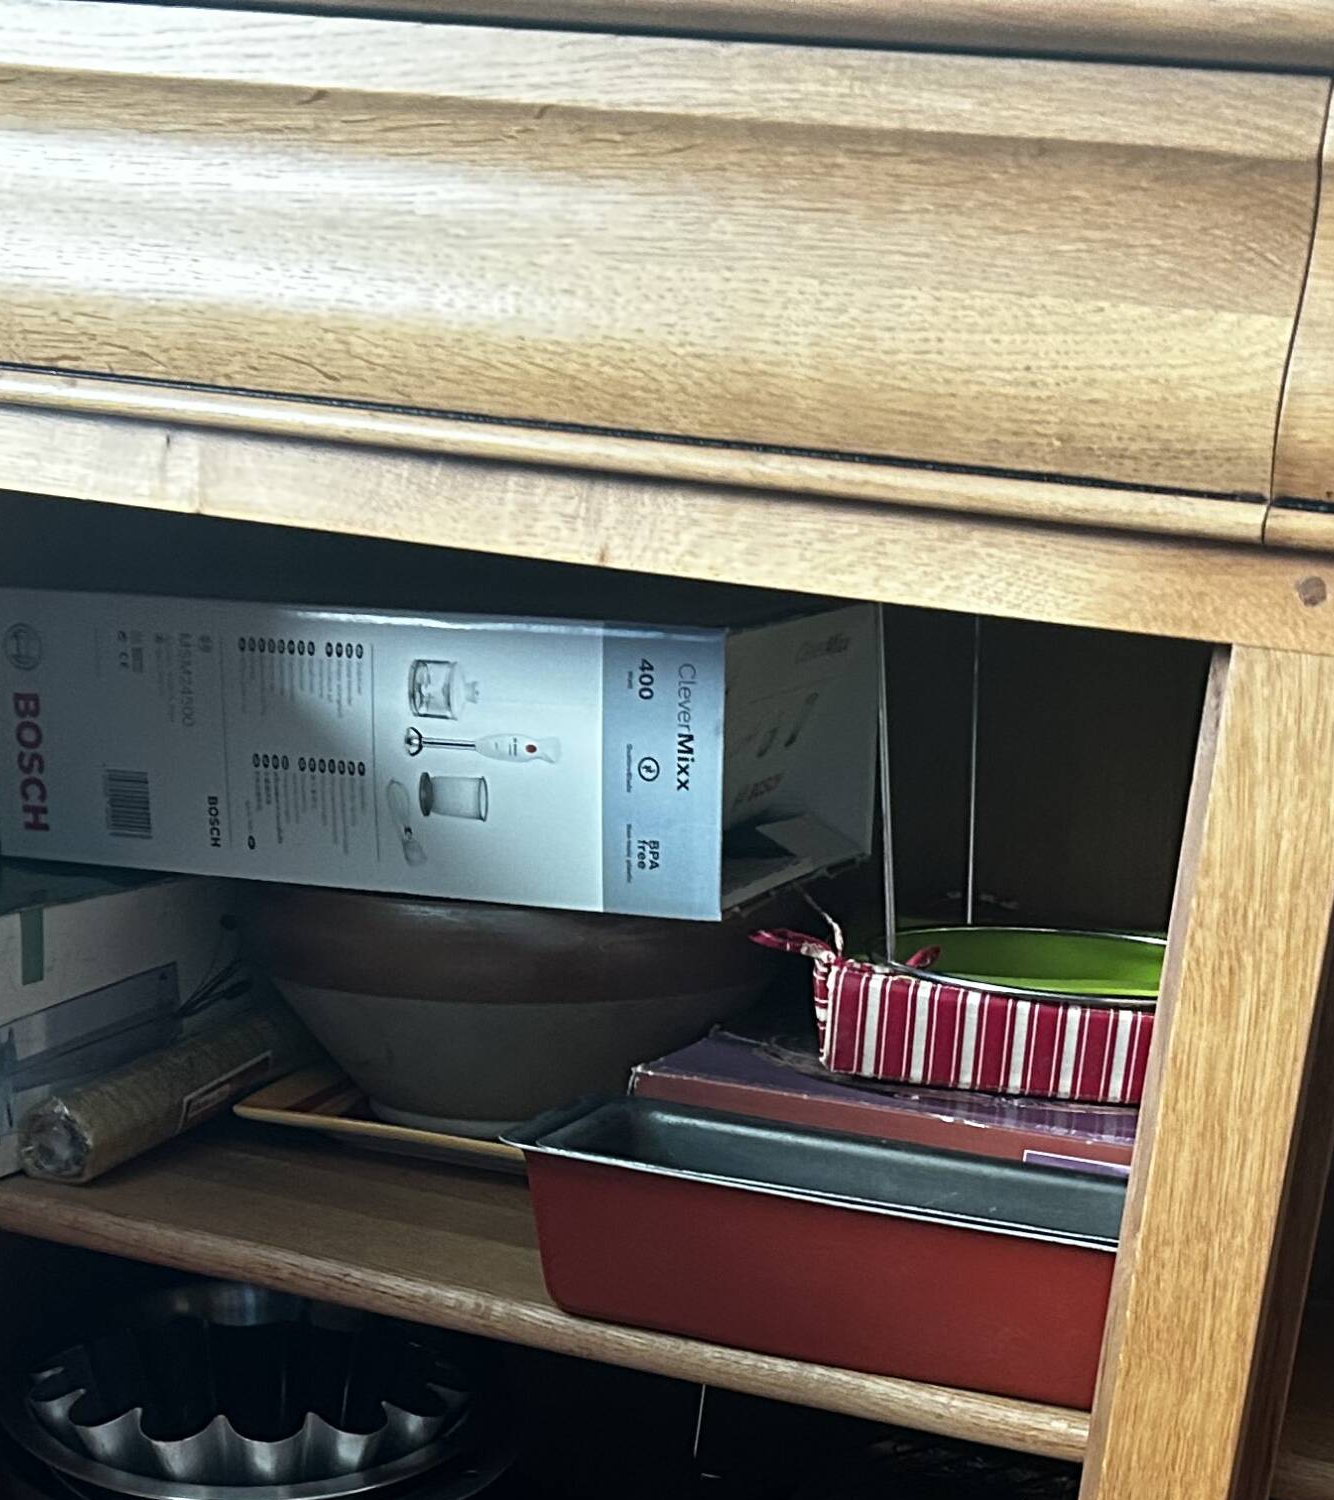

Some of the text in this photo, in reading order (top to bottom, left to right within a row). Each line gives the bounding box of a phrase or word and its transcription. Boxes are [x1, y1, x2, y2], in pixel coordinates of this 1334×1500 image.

[638, 658, 655, 700] 400
[677, 662, 697, 791] CleverMixx
[12, 691, 51, 832] BOSCH
[207, 795, 222, 848] BOSCH
[637, 839, 649, 870] free
[648, 840, 660, 870] BPA
